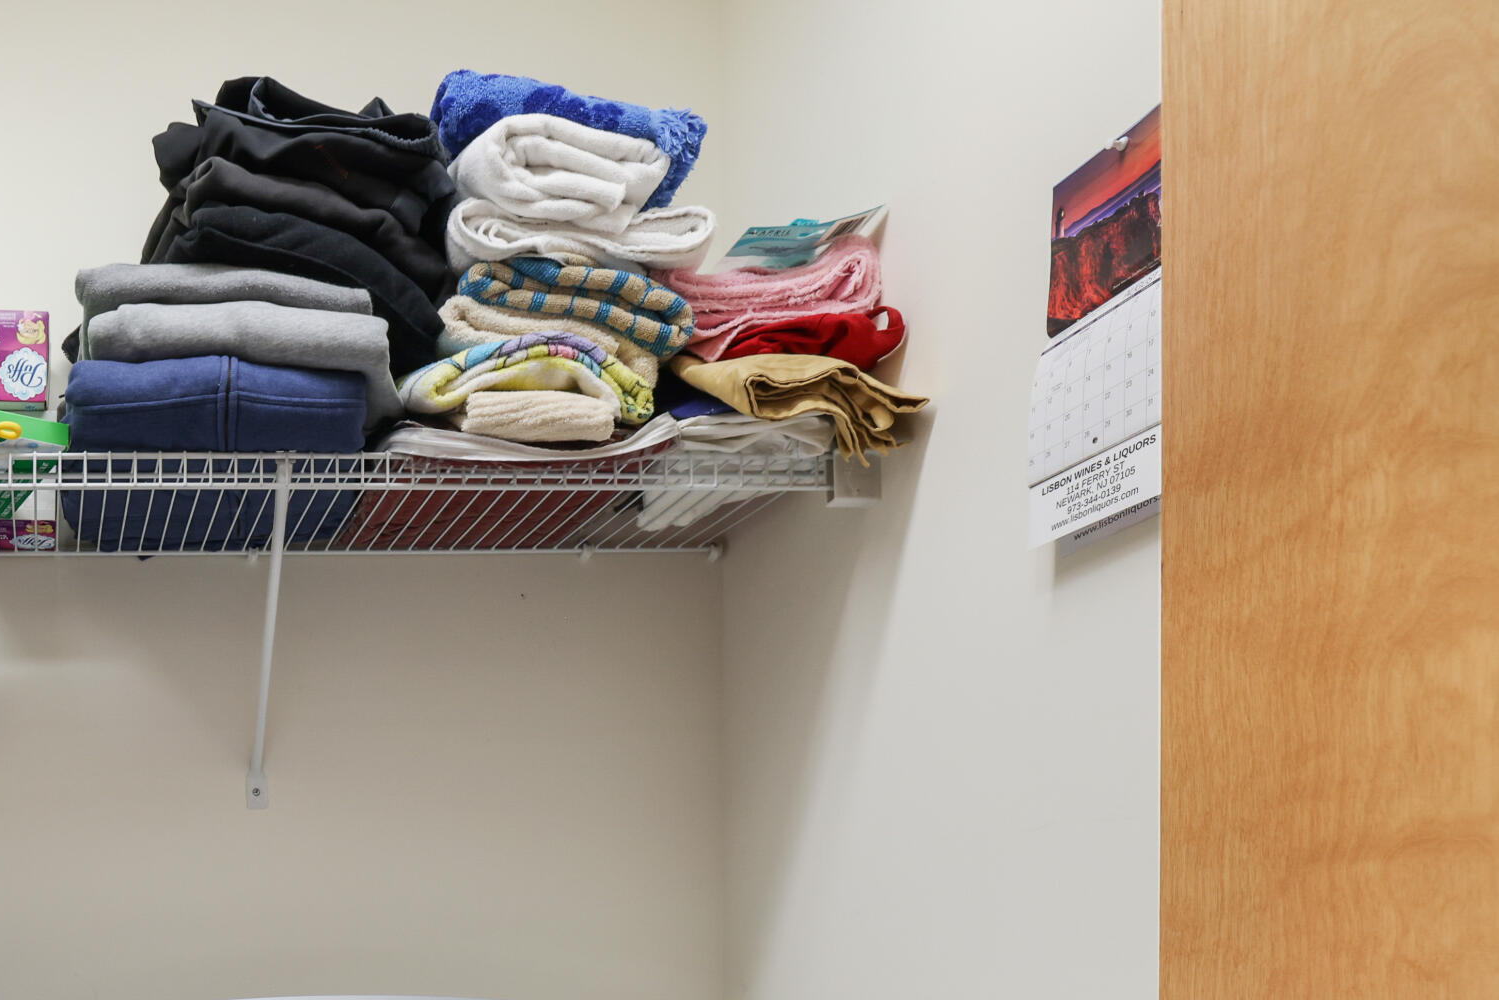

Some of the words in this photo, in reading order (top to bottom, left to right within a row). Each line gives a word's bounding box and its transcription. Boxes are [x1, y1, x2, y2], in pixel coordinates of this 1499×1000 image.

[6, 357, 45, 388] Puffs
[1041, 475, 1073, 497] LISBON
[1073, 460, 1103, 480] WINES
[1104, 456, 1111, 466] &
[1113, 434, 1157, 462] LIQUORS
[1066, 483, 1080, 496] 114
[1081, 466, 1112, 487] FERRY
[1113, 461, 1125, 473] ST
[1096, 480, 1108, 491] NJ
[1109, 465, 1136, 485] 07105
[1050, 486, 1140, 532] www.lisbonliquors.com
[1066, 483, 1122, 515] 973-344-0139
